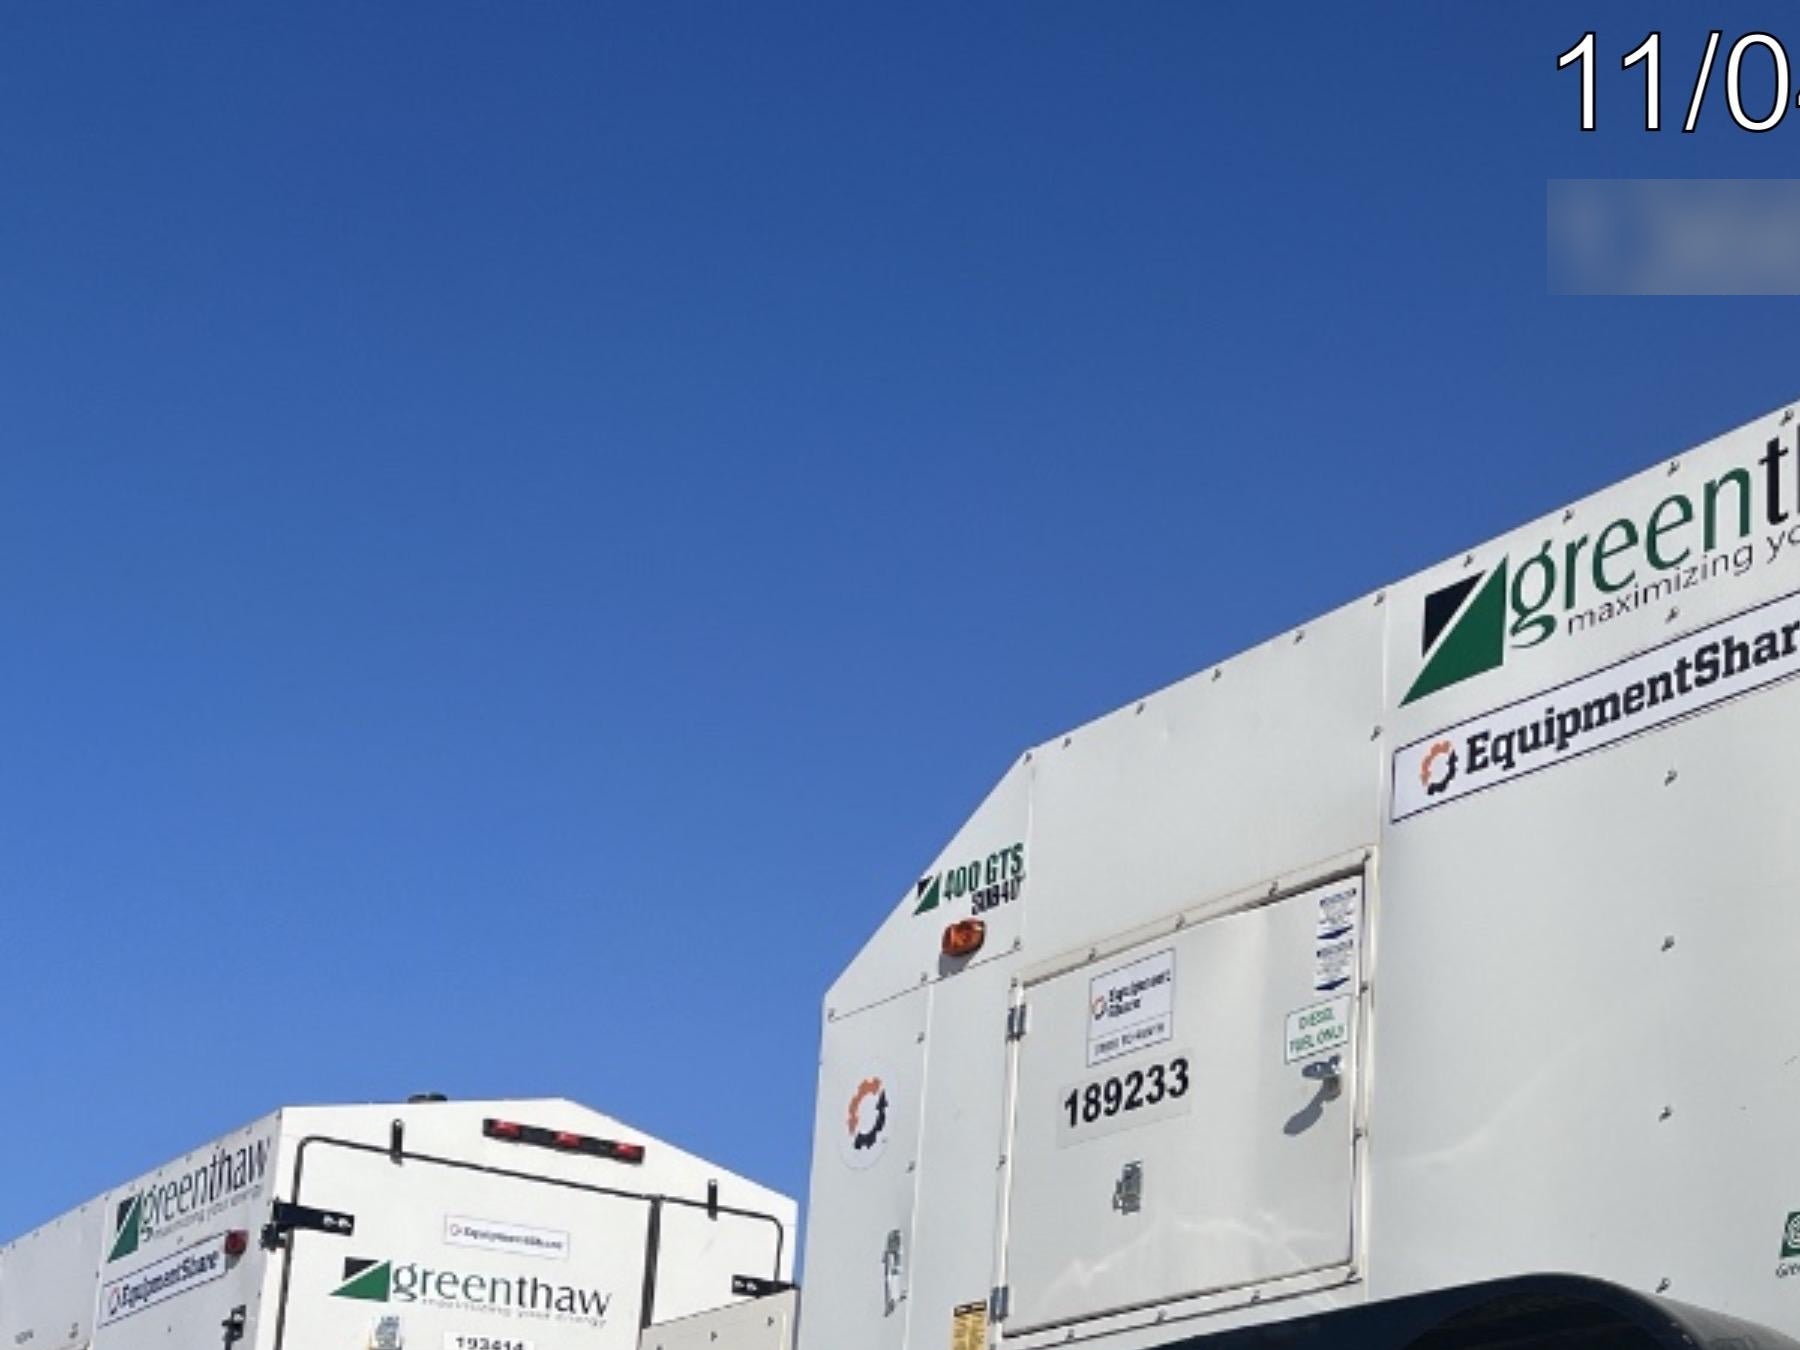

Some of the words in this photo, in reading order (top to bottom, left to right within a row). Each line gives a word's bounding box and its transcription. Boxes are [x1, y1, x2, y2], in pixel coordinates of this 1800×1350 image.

[1568, 543, 1754, 637] maximizing
[943, 859, 982, 902] 400
[985, 841, 1025, 886] GTS
[1064, 1057, 1189, 1129] 189233
[391, 1261, 612, 1318] greenthaw
